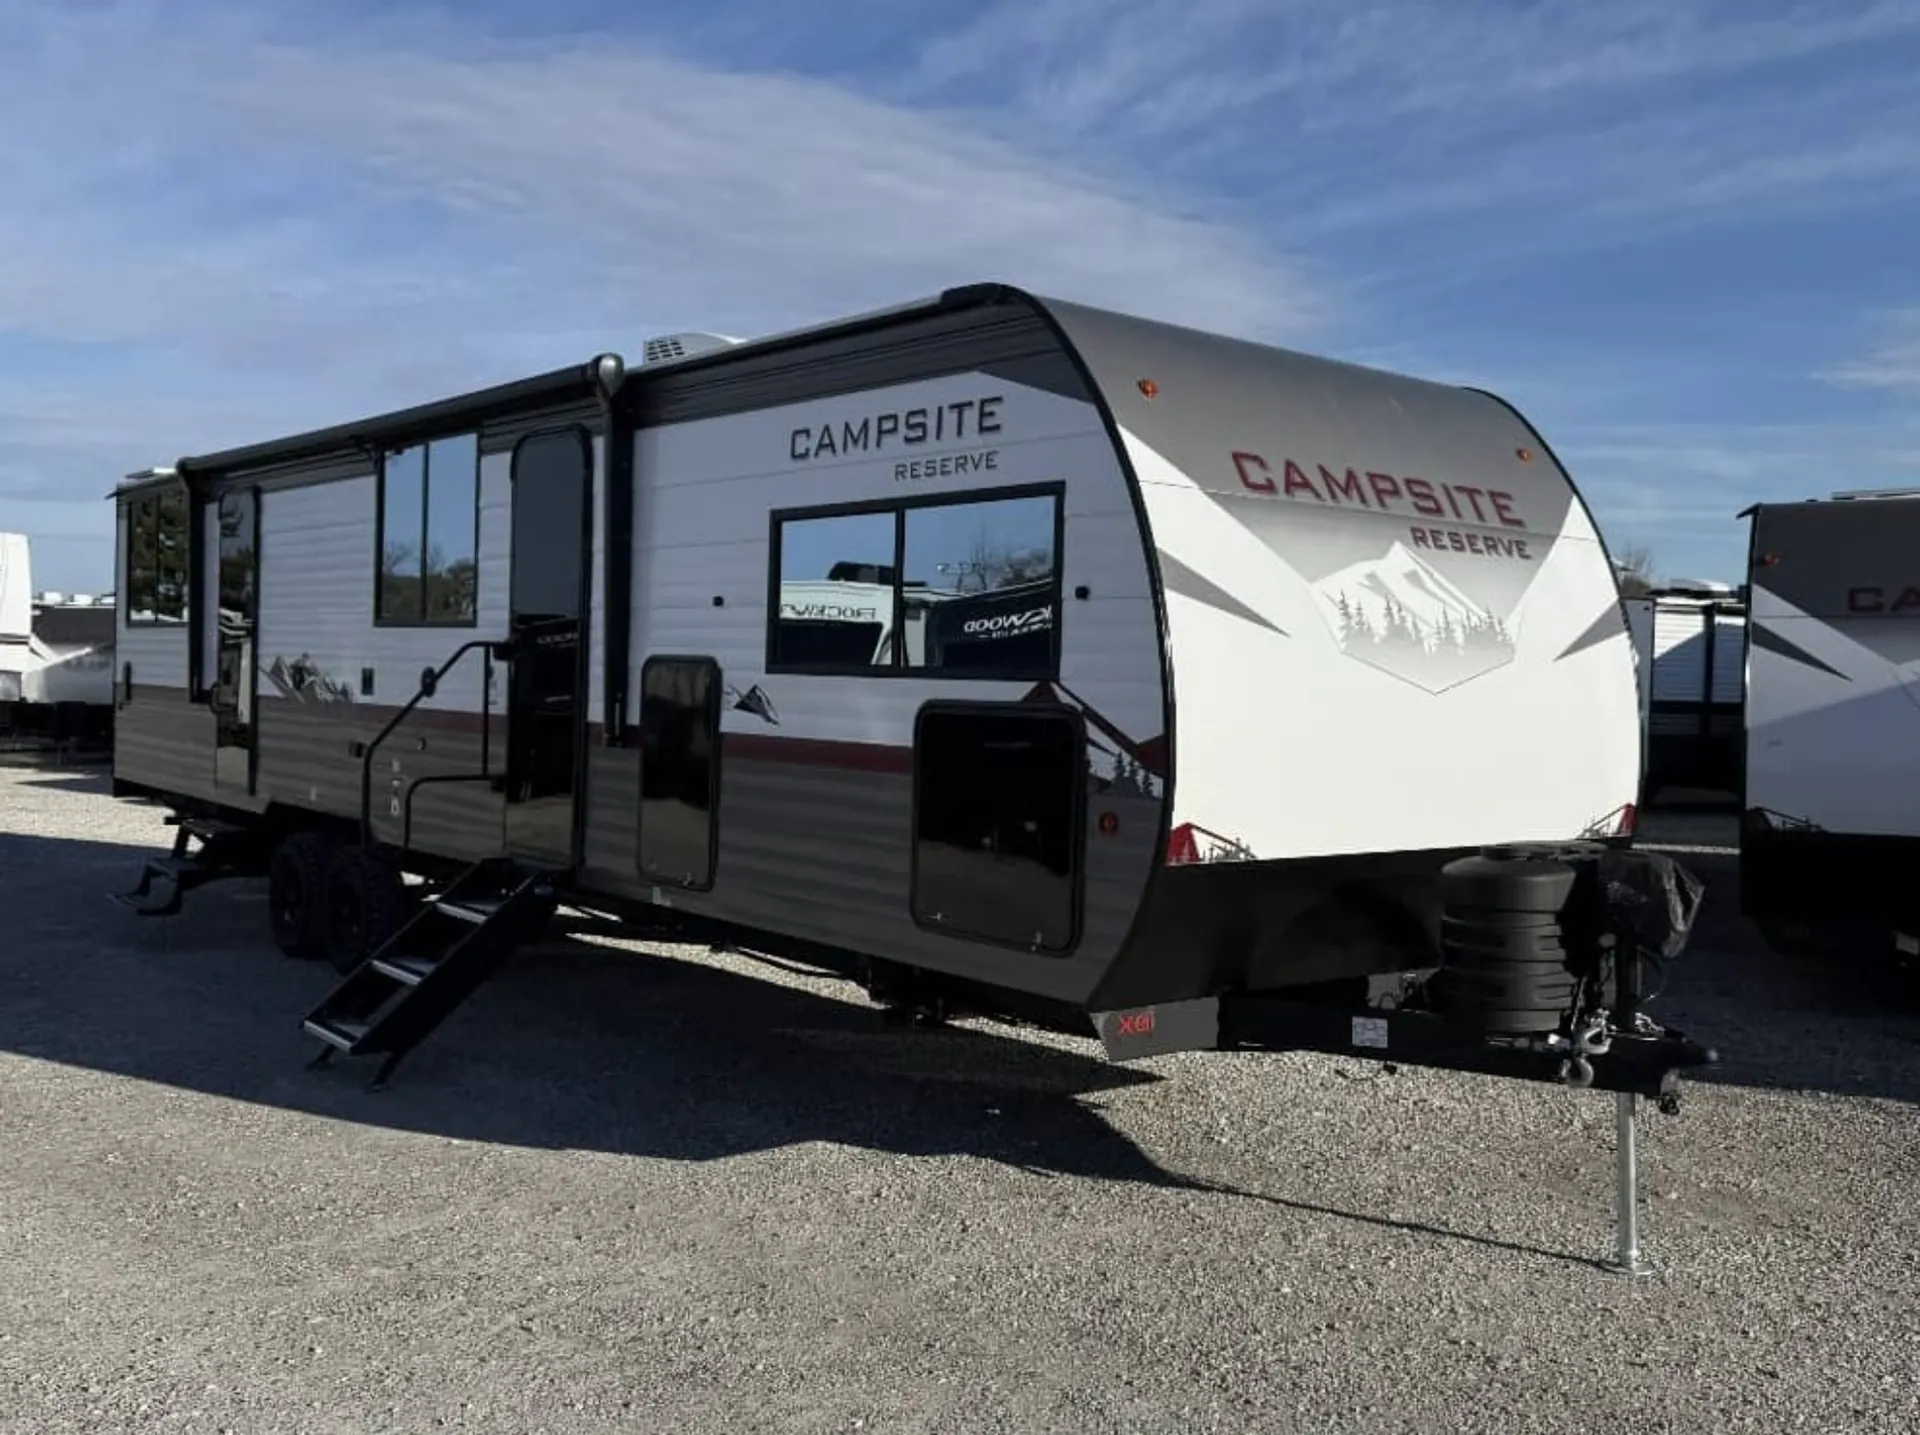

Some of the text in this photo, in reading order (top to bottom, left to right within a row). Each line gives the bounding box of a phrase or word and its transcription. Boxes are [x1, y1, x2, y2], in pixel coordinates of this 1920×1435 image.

[790, 396, 1004, 461] CAMPSITE
[894, 450, 1000, 481] RESERVE
[1231, 450, 1527, 528] CAMPSITE
[1410, 526, 1534, 560] RESERVE
